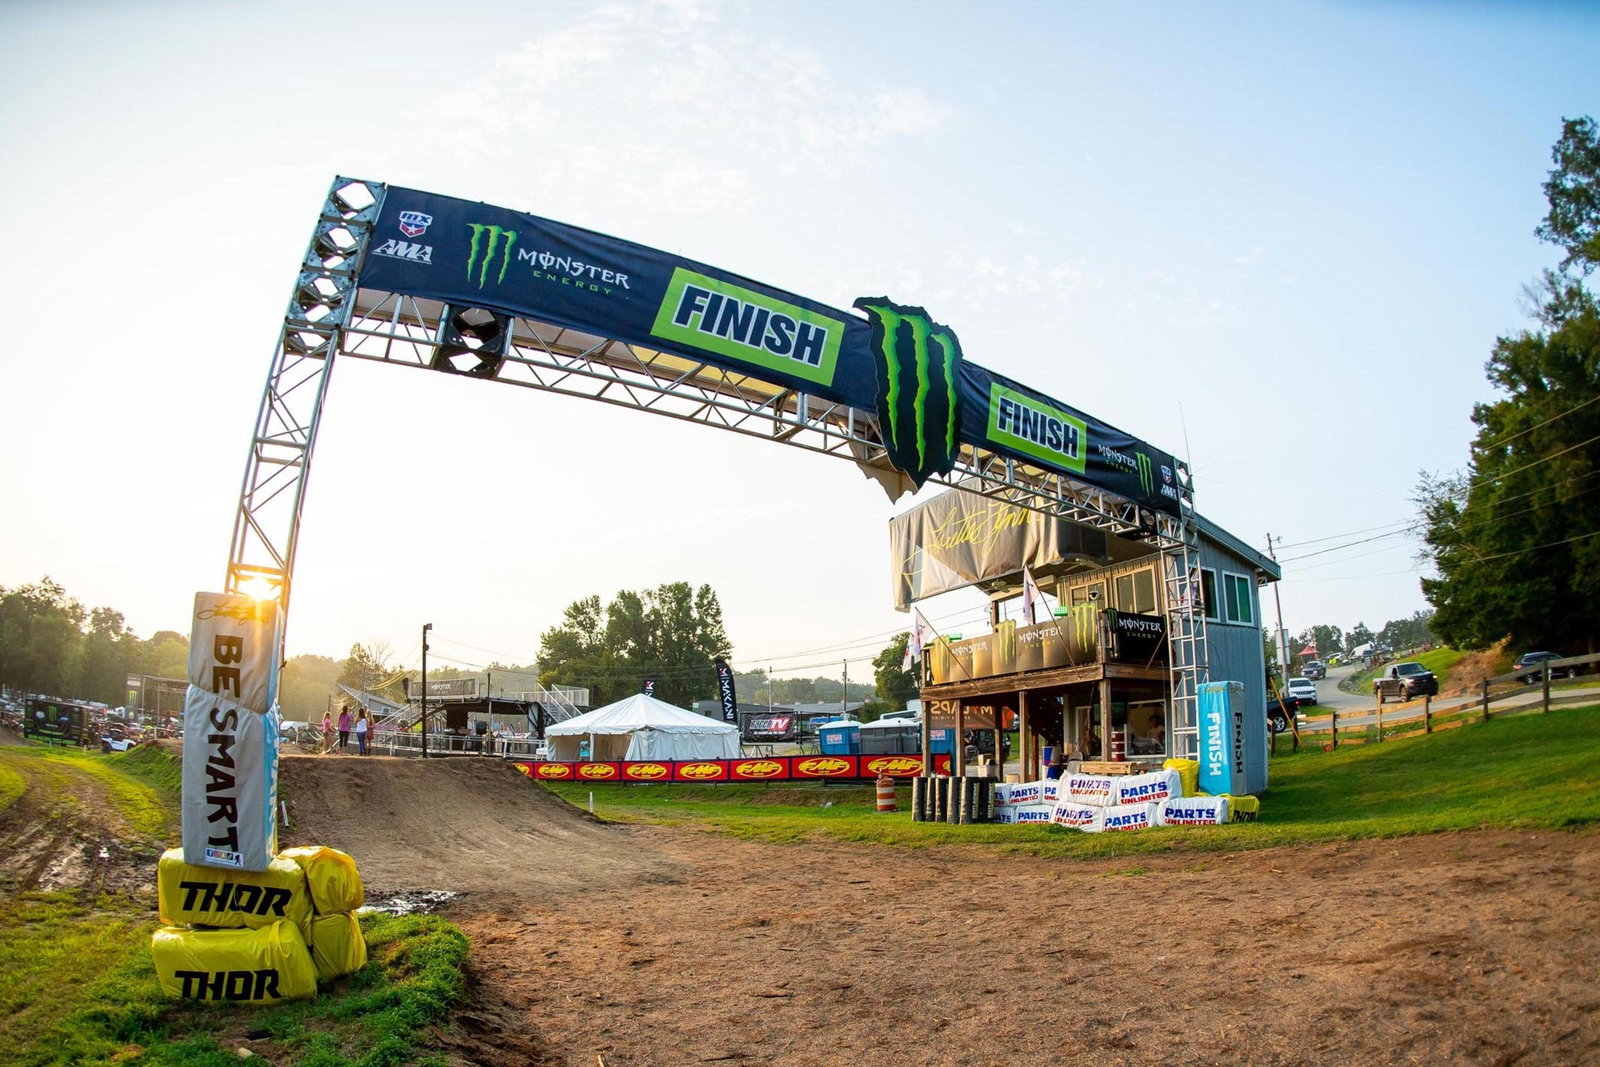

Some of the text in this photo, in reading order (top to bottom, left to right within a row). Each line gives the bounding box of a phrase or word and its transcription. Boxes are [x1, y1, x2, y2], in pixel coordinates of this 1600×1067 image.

[373, 239, 432, 261] AMA
[518, 248, 630, 289] MONSTER
[533, 270, 611, 295] ENERGY
[672, 283, 828, 368] FINISH
[997, 396, 1080, 460] FINISH
[1098, 444, 1138, 470] MONSTER
[1119, 618, 1162, 632] MONSTER
[1018, 626, 1063, 644] MONSTER
[212, 634, 244, 698] BE
[1207, 712, 1222, 776] FINISH
[627, 765, 665, 774] FMF
[680, 765, 720, 774] FMF
[737, 762, 782, 773] FMF
[799, 760, 848, 771] FMF
[868, 760, 923, 770] FMF
[206, 706, 239, 852] SMART
[1009, 787, 1039, 799] PARTS
[1120, 781, 1168, 798] PARTS
[1121, 791, 1169, 805] UNLIMITED
[1009, 795, 1039, 804] UNLIMITED
[1018, 812, 1049, 820] PARTS
[1105, 812, 1146, 827] PARTS
[1165, 807, 1216, 819] PARTS
[179, 881, 292, 916] THOR
[174, 968, 282, 1000] THOR
